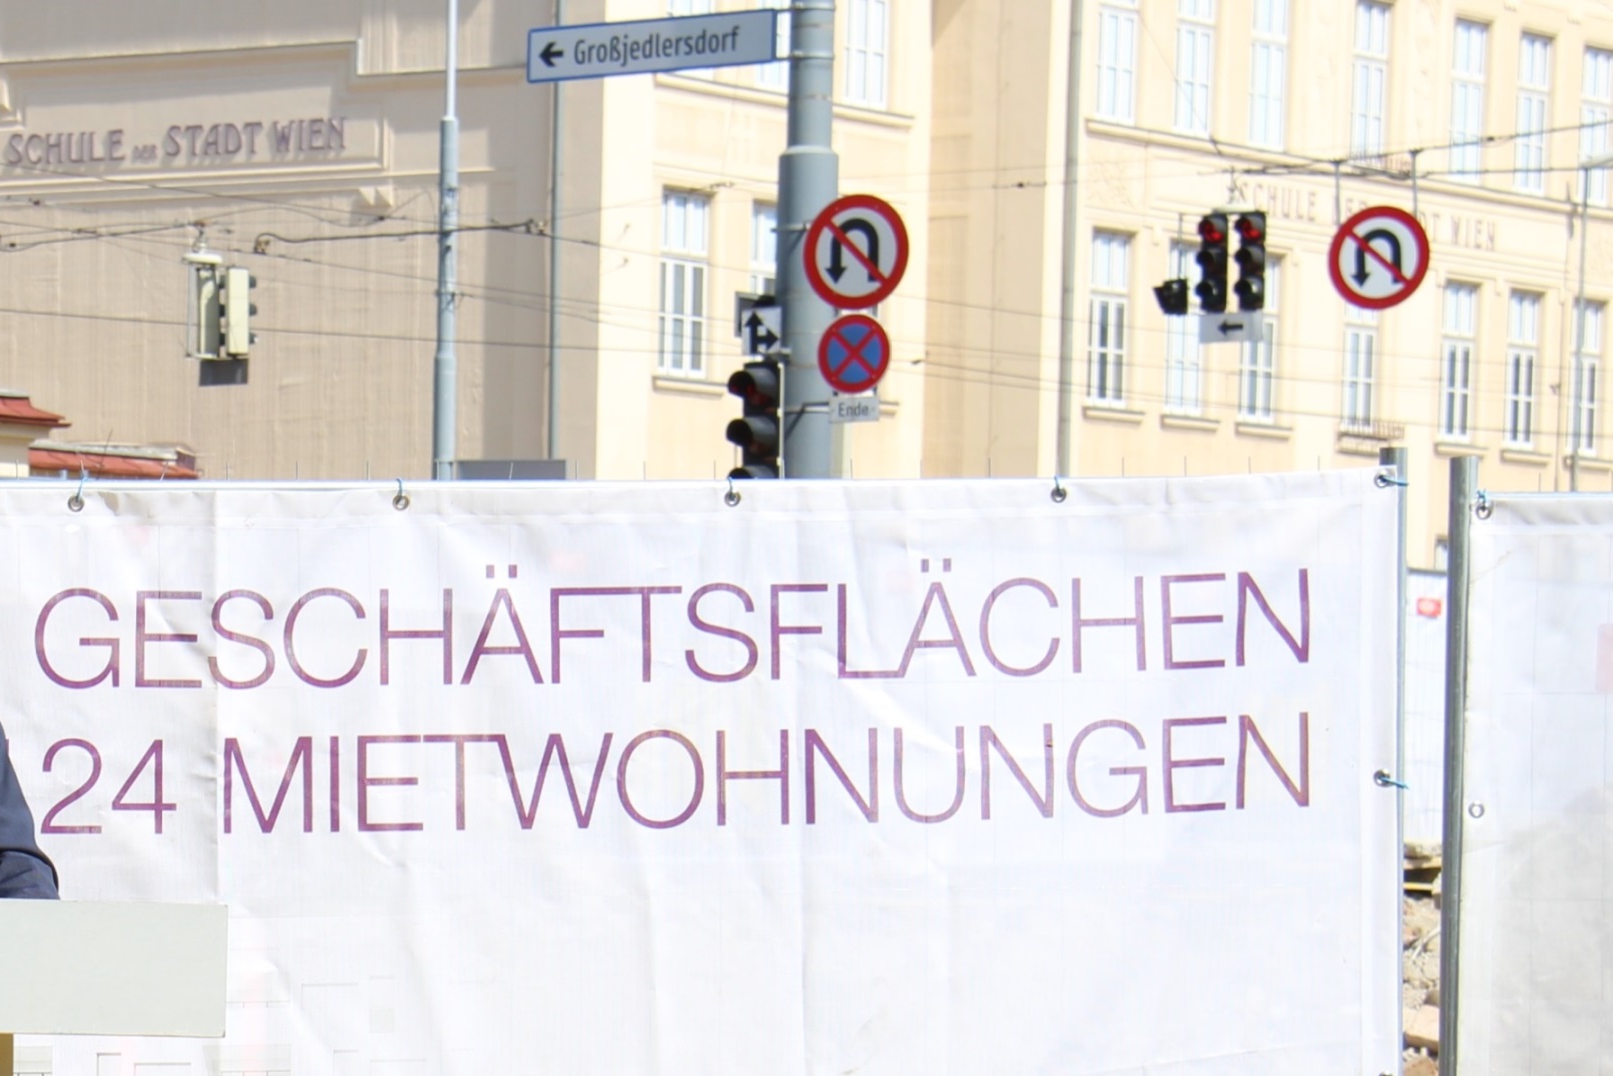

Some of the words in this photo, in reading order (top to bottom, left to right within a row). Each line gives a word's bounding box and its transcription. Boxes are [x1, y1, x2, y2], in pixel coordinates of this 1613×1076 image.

[573, 26, 740, 67] Großjedlersdorf
[6, 129, 126, 165] SCHULE
[164, 120, 263, 158] STADT
[272, 117, 346, 154] WIEN
[838, 402, 869, 417] Ende
[34, 557, 1310, 690] GESCHÄFTSFLÄCHEN
[222, 711, 1310, 835] MIETWOHNUNGEN
